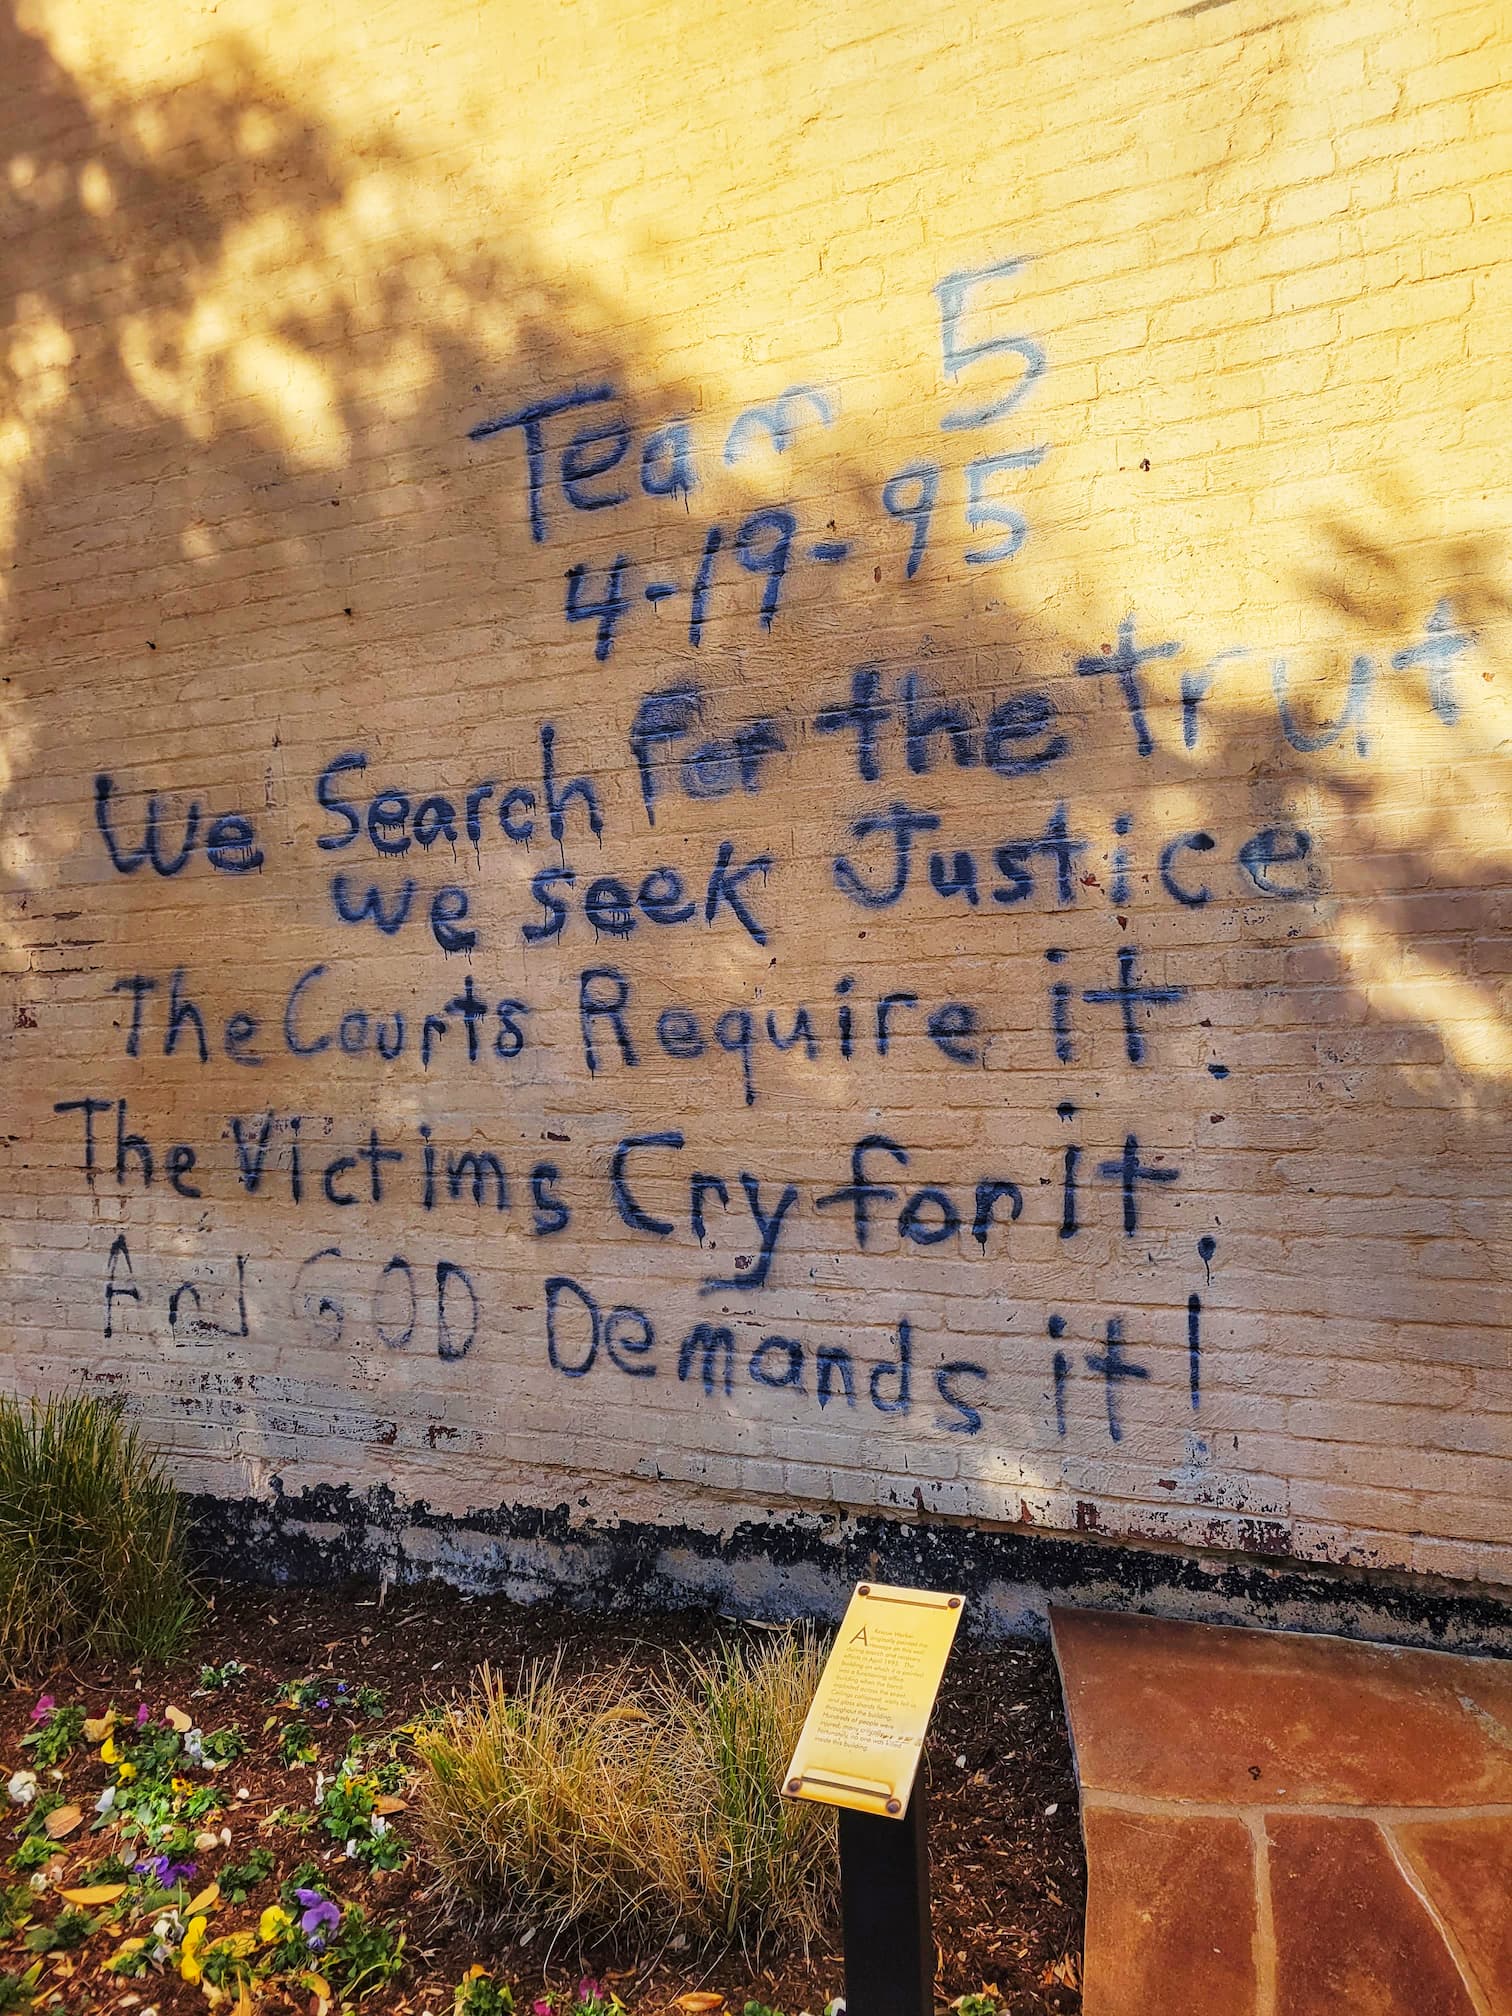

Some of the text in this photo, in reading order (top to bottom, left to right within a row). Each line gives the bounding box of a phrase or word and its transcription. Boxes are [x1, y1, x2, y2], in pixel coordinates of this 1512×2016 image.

[934, 254, 1048, 431] 5
[468, 382, 836, 544] Team
[93, 773, 266, 877] We
[315, 721, 604, 858] Search
[813, 668, 1074, 781] the
[834, 800, 1313, 910] Justice
[111, 965, 262, 1067] The
[284, 963, 532, 1071] Courts
[580, 965, 984, 1105] Require
[54, 1096, 202, 1199] The
[232, 1110, 571, 1236] Victims
[610, 1131, 799, 1296] Cry
[815, 1132, 1024, 1251] for
[544, 1277, 988, 1437] Demands
[849, 1625, 867, 1646] A
